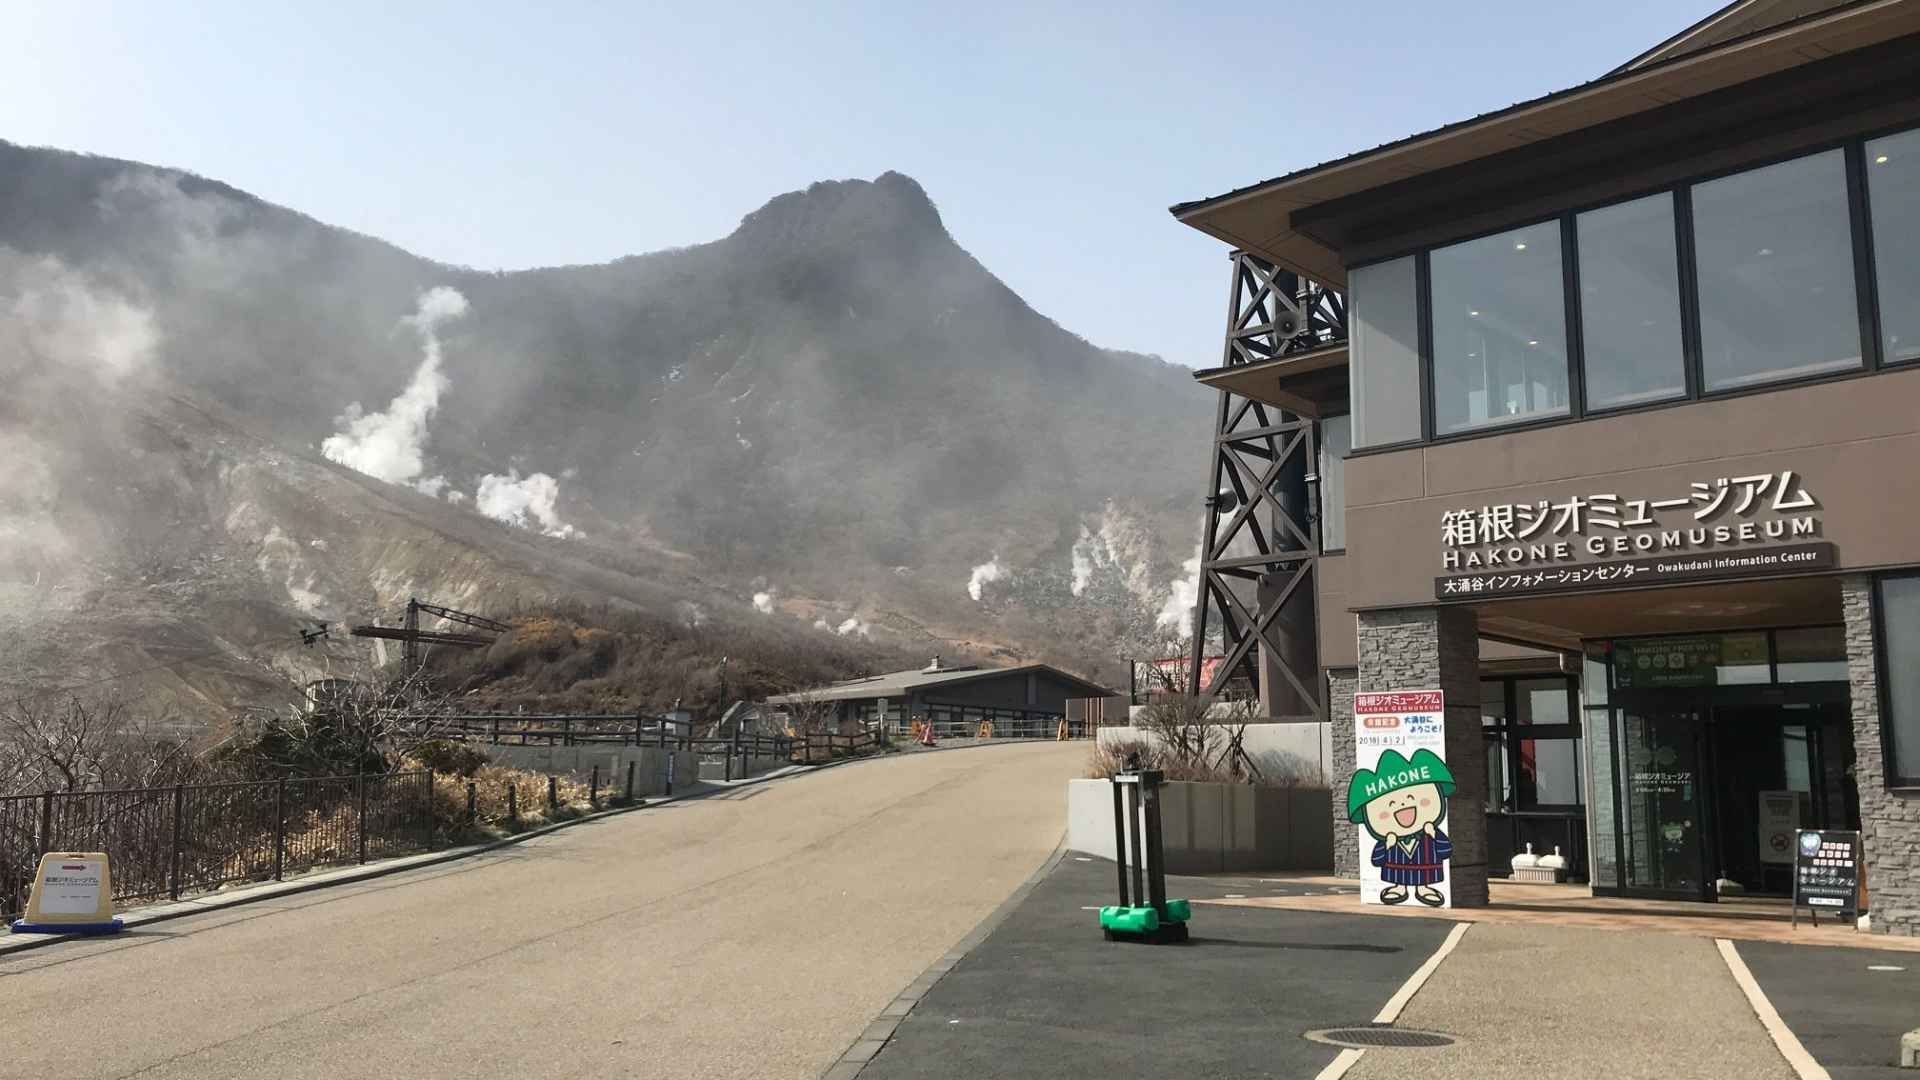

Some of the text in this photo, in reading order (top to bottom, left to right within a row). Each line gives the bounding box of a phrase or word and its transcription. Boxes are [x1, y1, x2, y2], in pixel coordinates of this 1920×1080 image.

[1441, 470, 1815, 546] 箱根ジオミュージアム
[1443, 516, 1814, 569] HAKONE GEOMUSEUM
[1657, 552, 1817, 573] Owakudani Information Center
[1444, 564, 1650, 594] 大涌谷インフォメーションセンター
[1358, 693, 1440, 707] 箱根ジオミュージアム
[1365, 766, 1431, 797] HAKONE
